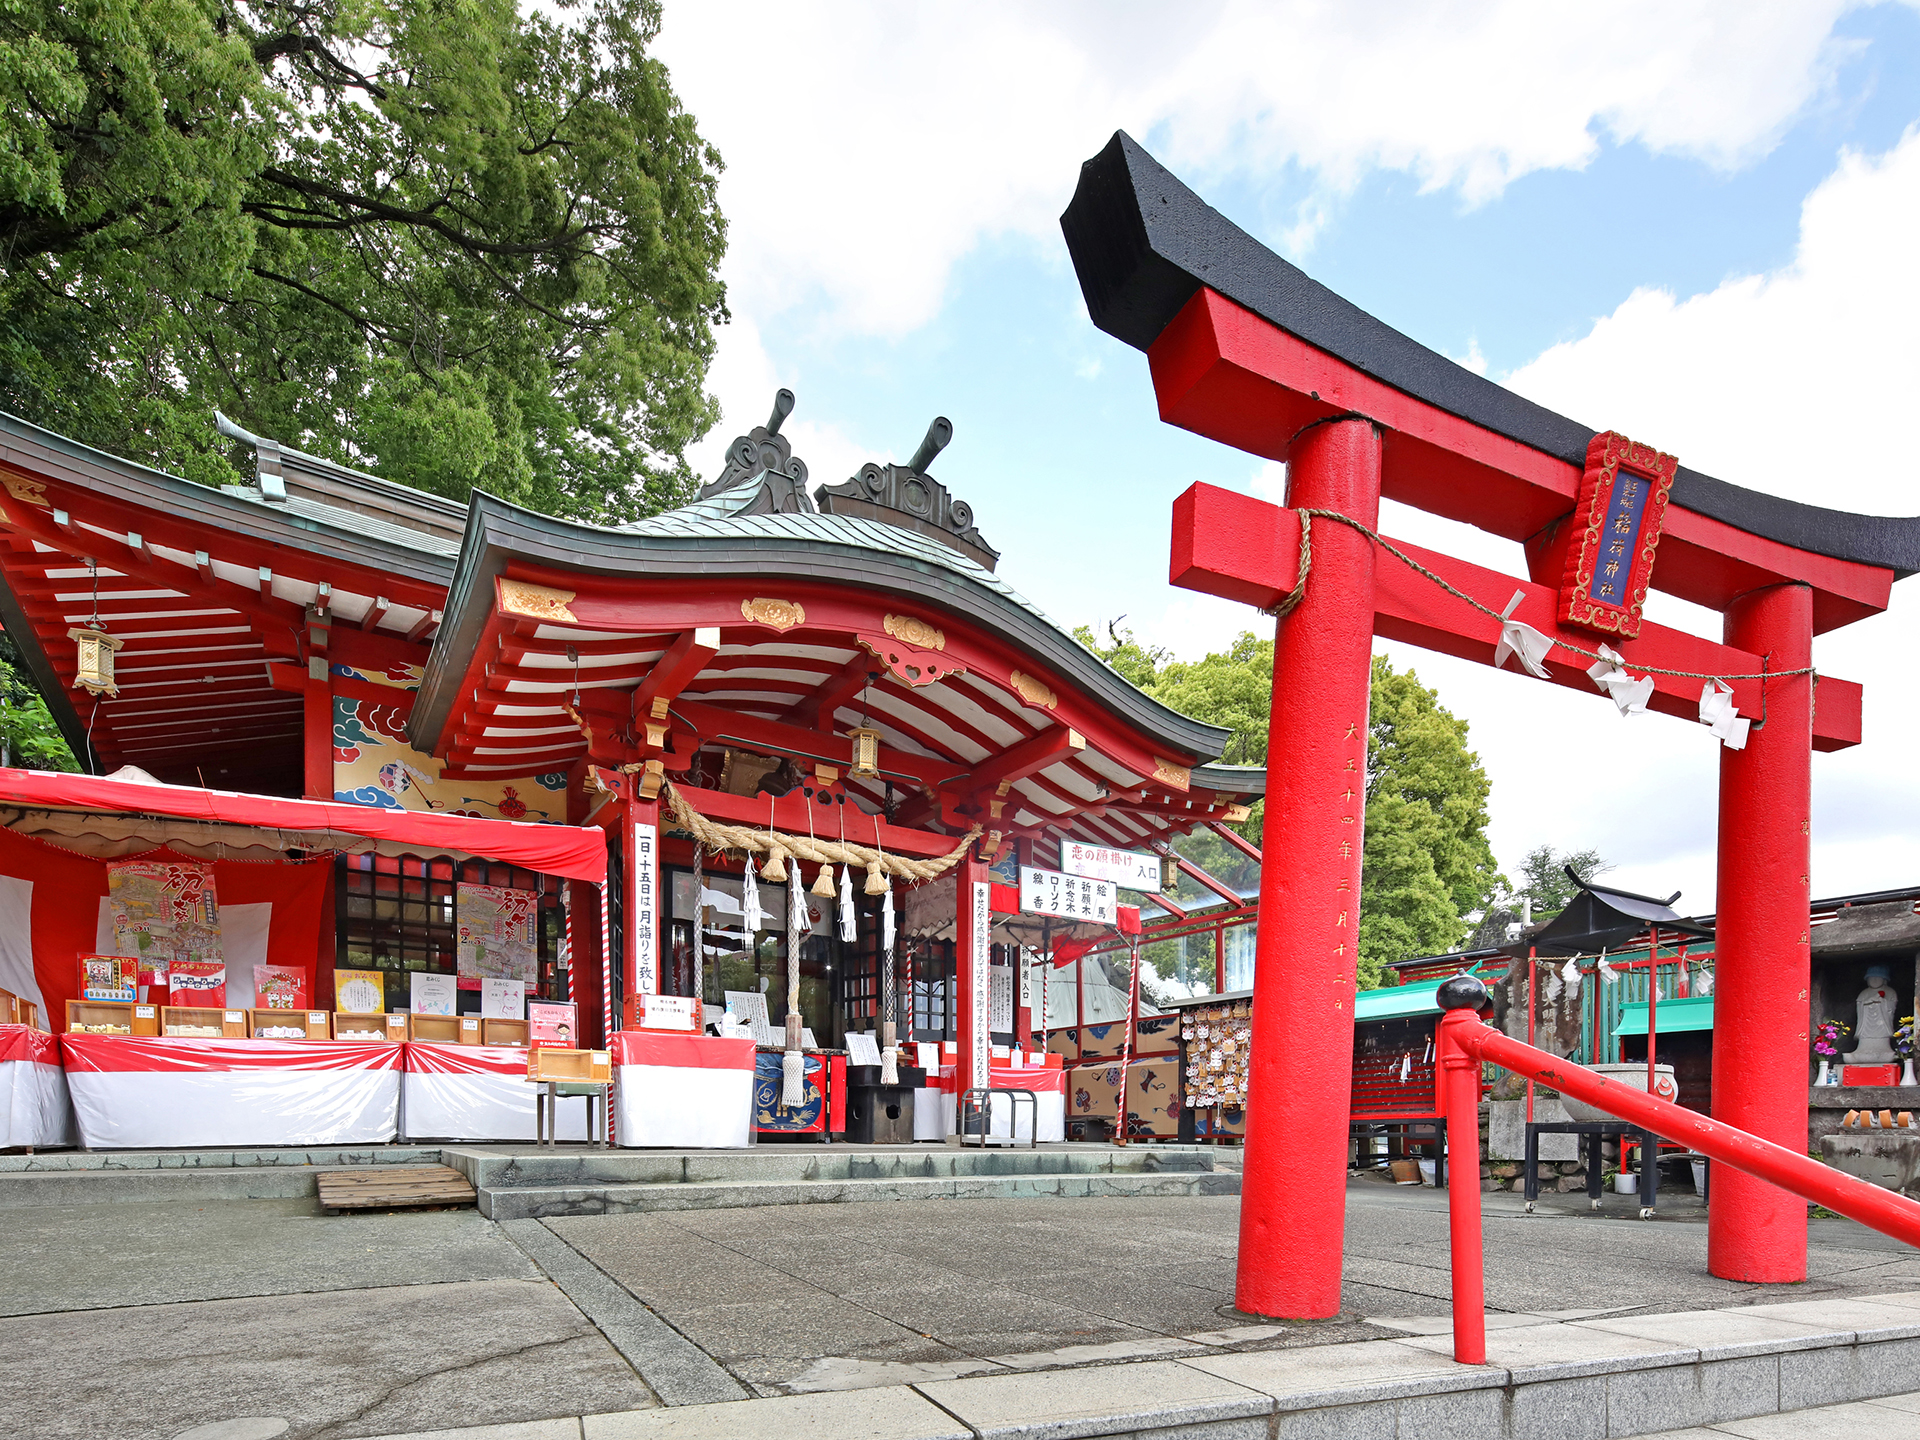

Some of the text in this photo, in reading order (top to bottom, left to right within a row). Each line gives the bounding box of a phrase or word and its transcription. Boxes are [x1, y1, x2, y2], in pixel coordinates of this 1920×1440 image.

[1599, 511, 1632, 597] 稲荷神社
[1072, 845, 1132, 867] 恋の願掛け
[1137, 866, 1157, 880] 入口
[1333, 723, 1360, 1009] 大正十四年三月十二日
[1033, 873, 1044, 909] 線香
[1050, 876, 1059, 911] ローソク
[1065, 879, 1076, 913] 祈念木
[1081, 882, 1091, 916] 祈願木
[1096, 884, 1107, 919] 絵馬
[639, 835, 653, 995] 一日・十五日は月詣りを致し
[1021, 947, 1030, 998] 祈願者入口
